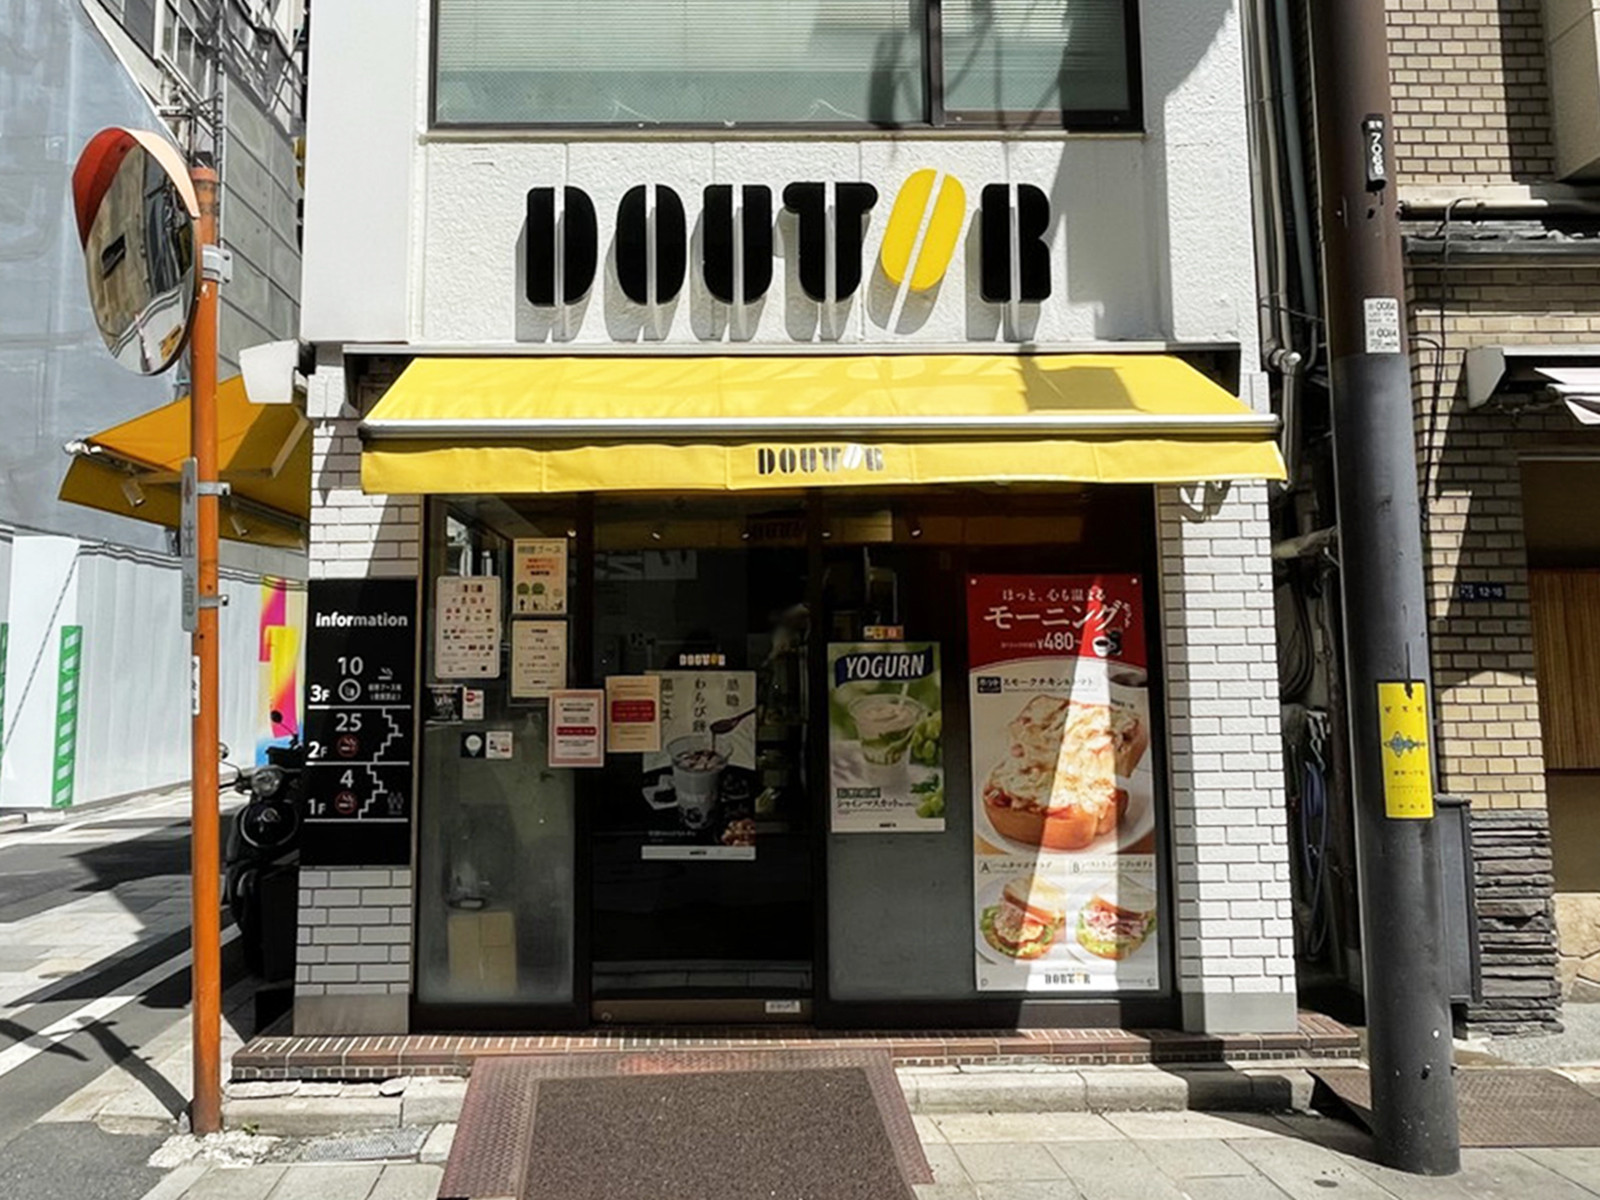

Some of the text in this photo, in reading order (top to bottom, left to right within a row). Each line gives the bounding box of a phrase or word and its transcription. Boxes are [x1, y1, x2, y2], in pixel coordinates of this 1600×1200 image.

[526, 168, 1051, 305] DOUTOR
[757, 443, 885, 475] DOUTOR
[315, 612, 408, 627] information
[984, 600, 1121, 631] モーニング
[337, 657, 363, 676] 10
[846, 654, 925, 679] YOGURN
[309, 685, 330, 702] 3F
[335, 713, 362, 732] 25
[307, 741, 328, 759] 2F
[340, 769, 354, 788] 4
[307, 798, 326, 815] 1F
[980, 862, 991, 873] A
